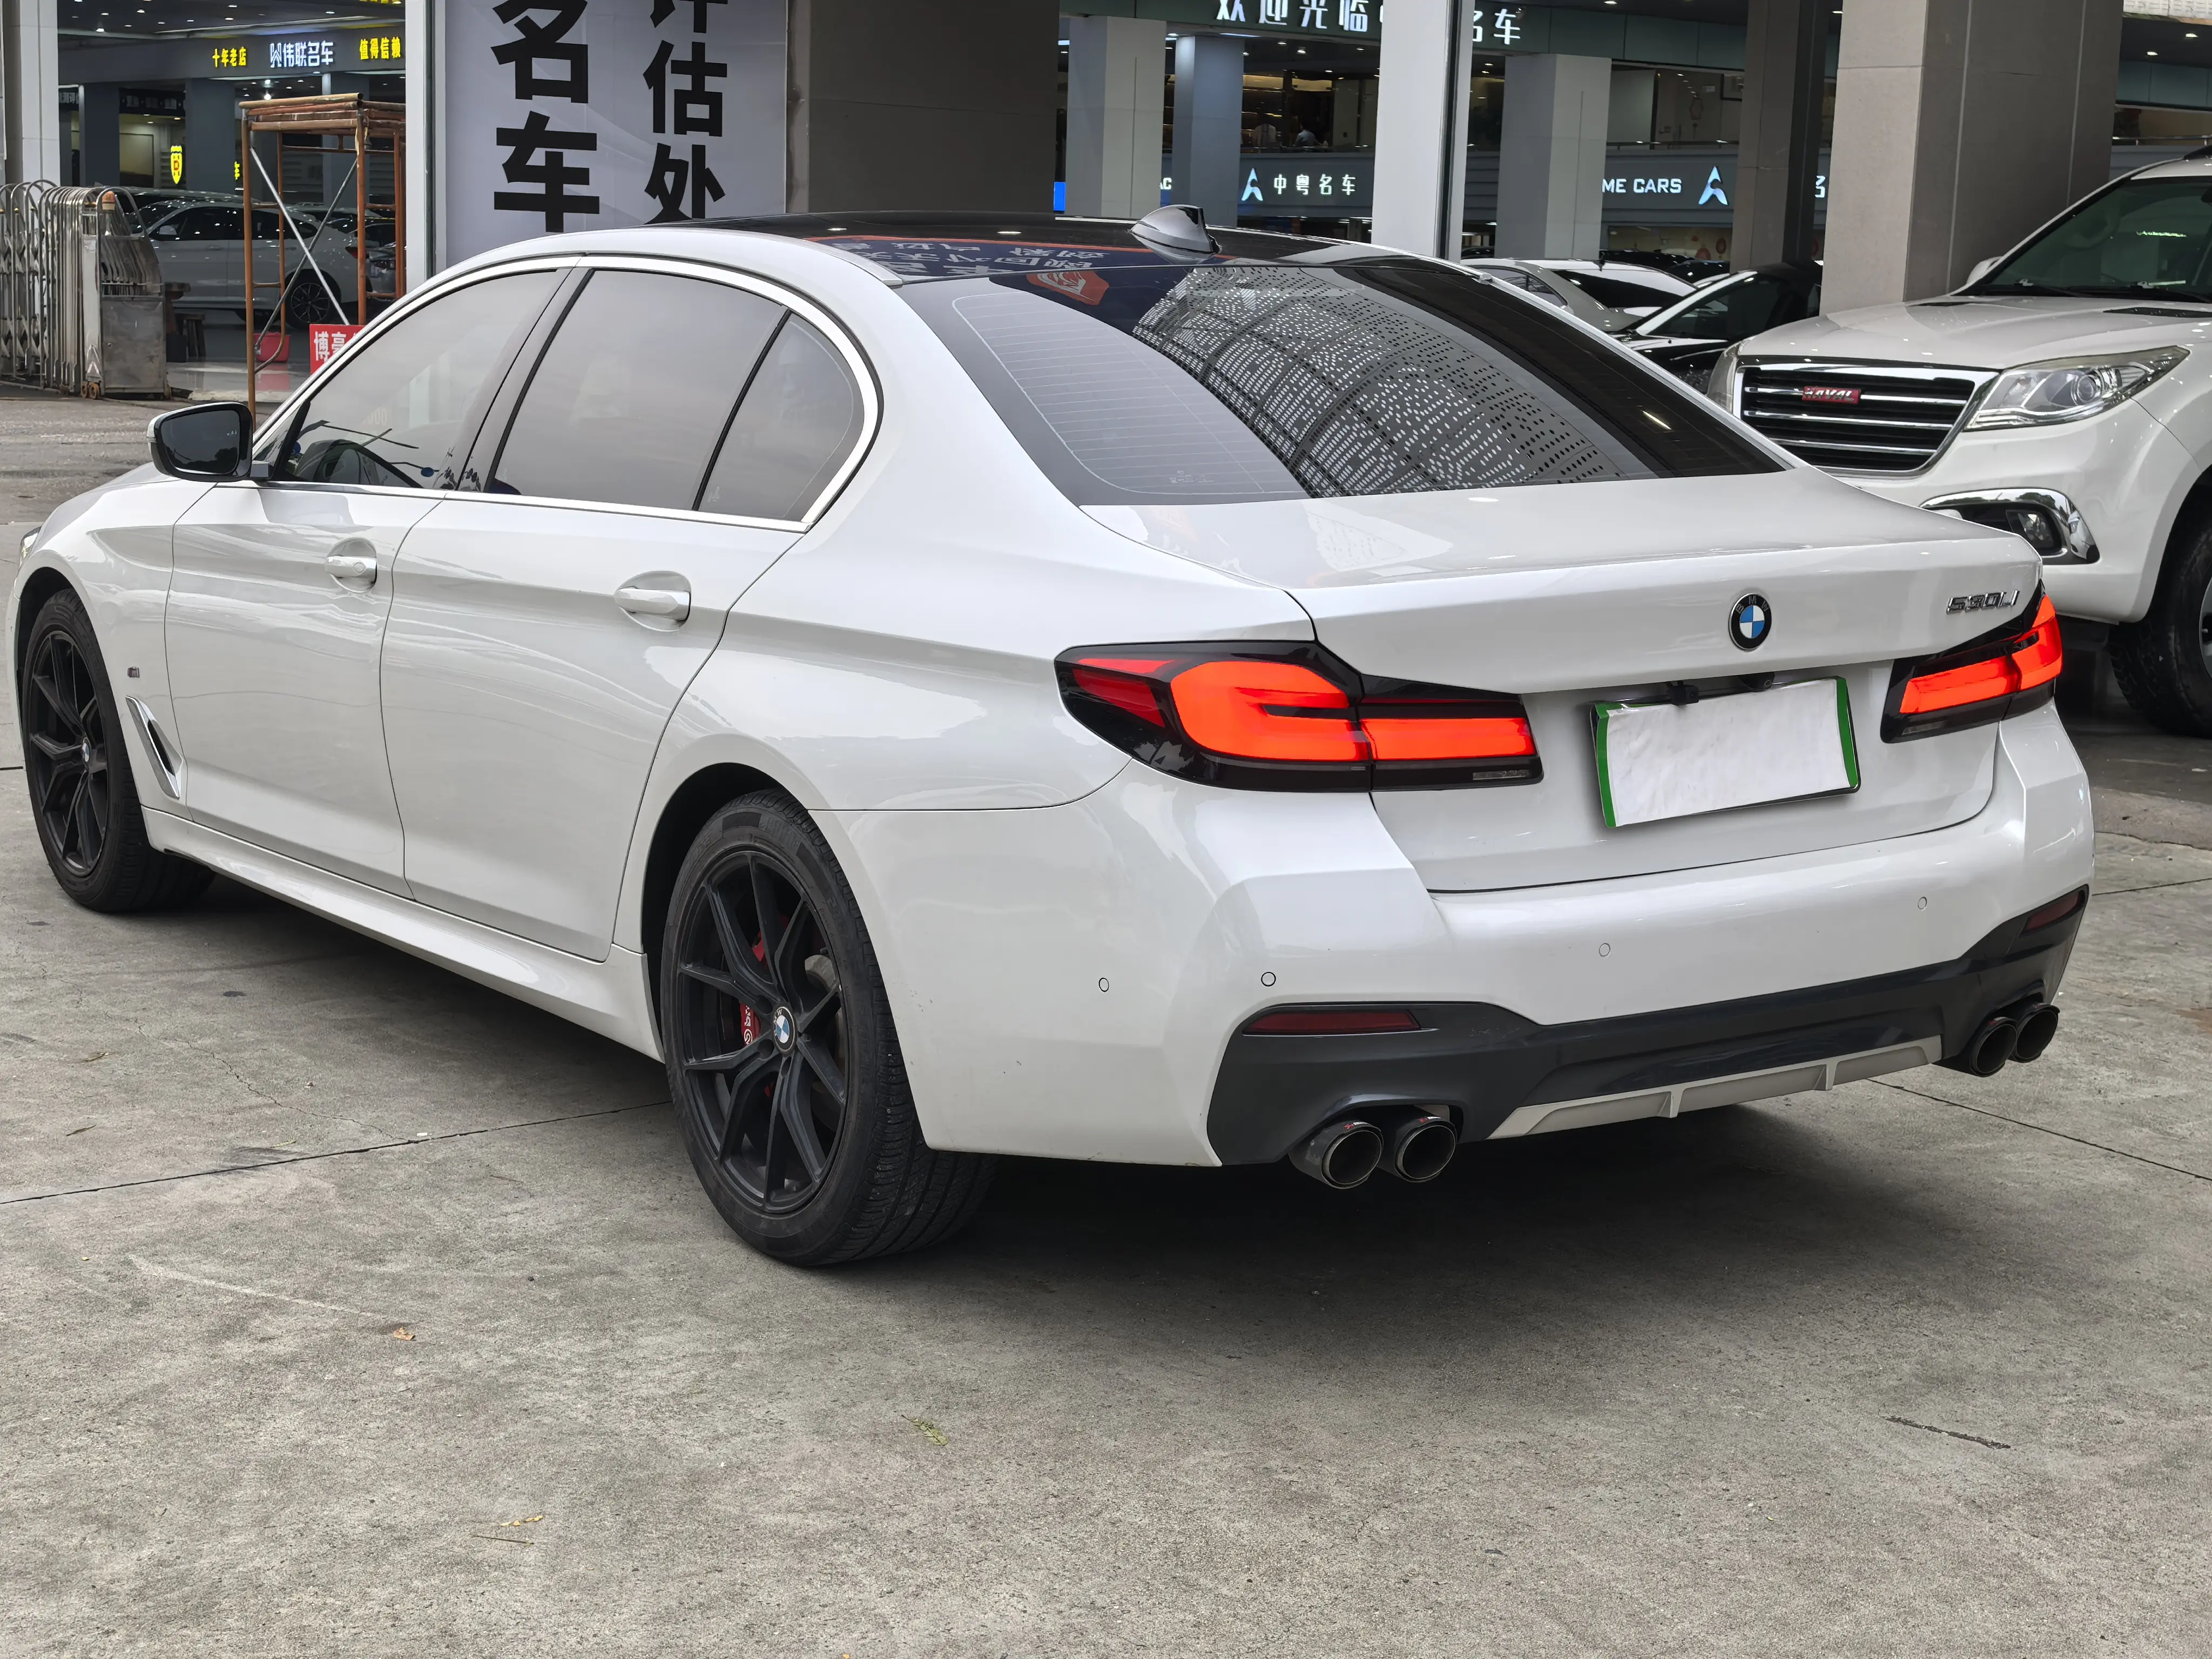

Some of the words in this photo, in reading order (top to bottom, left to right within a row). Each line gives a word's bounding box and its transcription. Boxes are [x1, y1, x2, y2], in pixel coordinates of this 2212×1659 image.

[212, 46, 247, 68] 十年老店
[283, 40, 334, 68] 伟联名车
[359, 36, 401, 60] 值得信赖
[490, 0, 600, 233] 名车
[1273, 174, 1357, 196] 中粤名车
[1633, 178, 1682, 193] CARS
[1735, 595, 1769, 615] BMW
